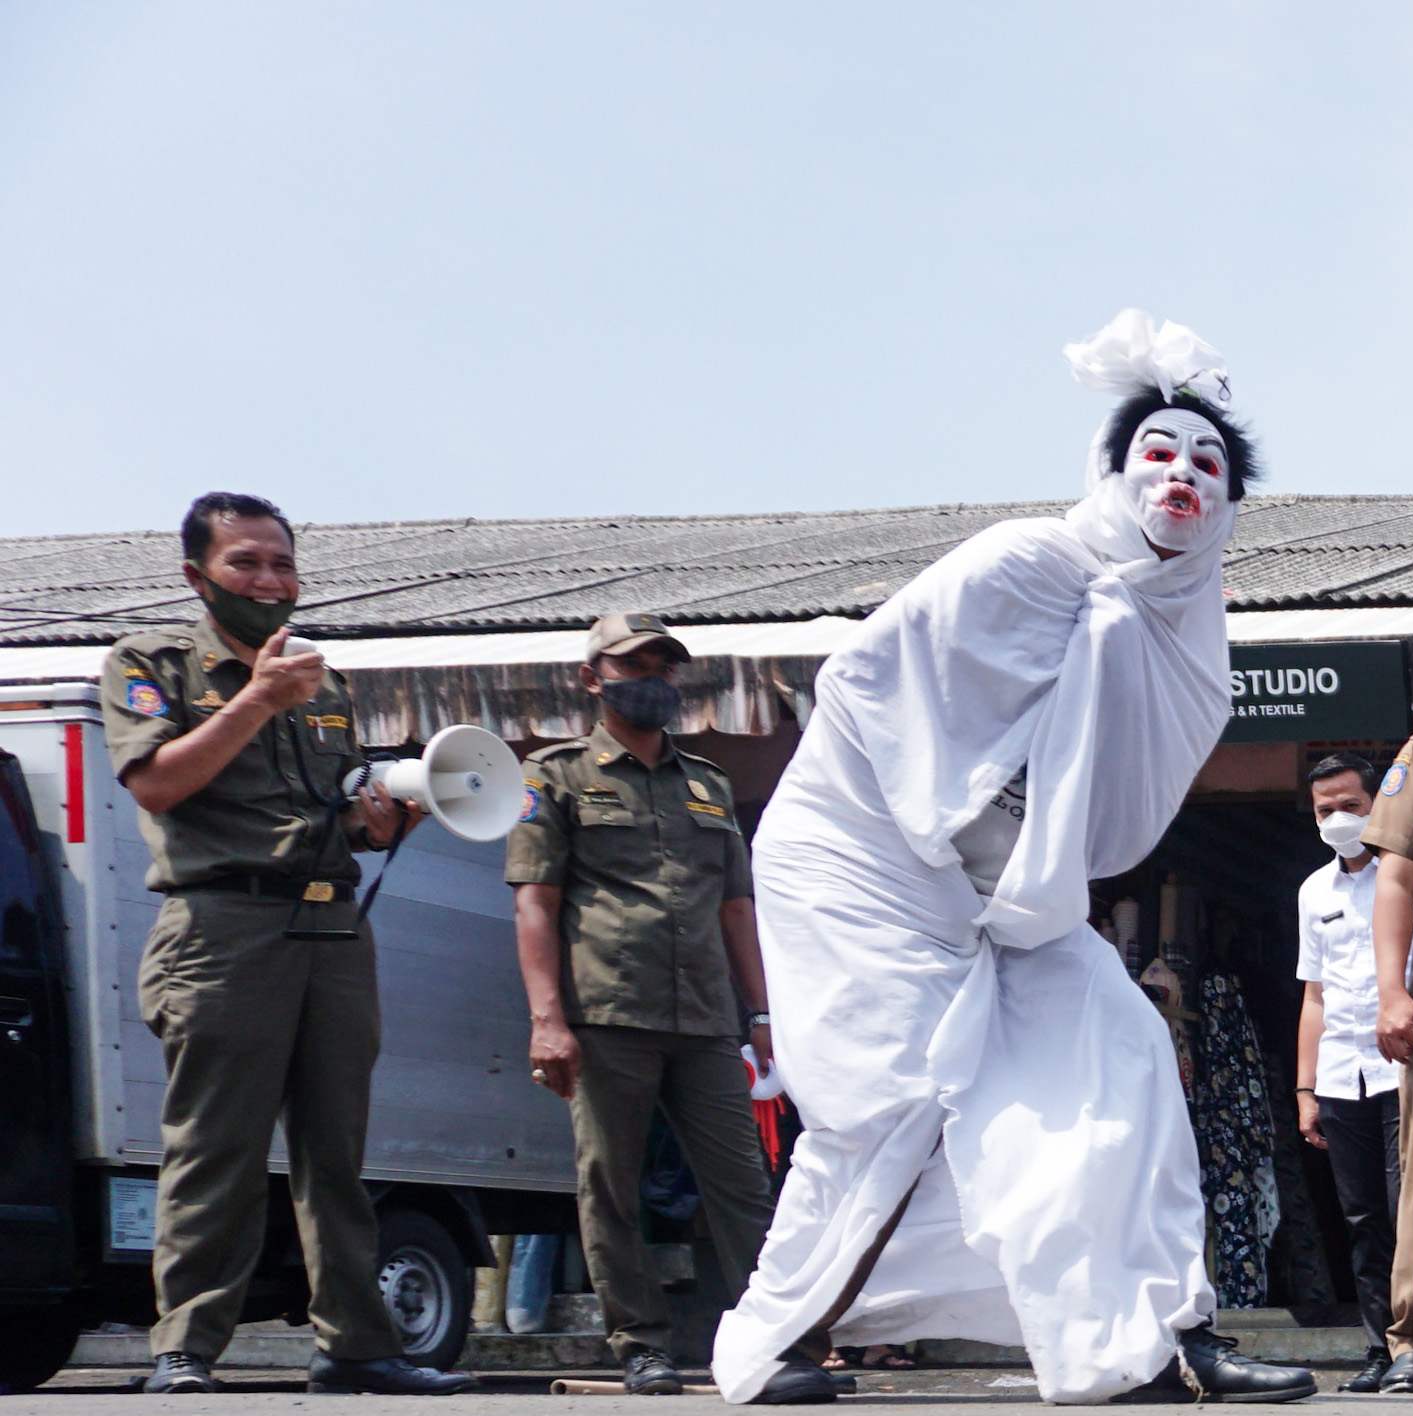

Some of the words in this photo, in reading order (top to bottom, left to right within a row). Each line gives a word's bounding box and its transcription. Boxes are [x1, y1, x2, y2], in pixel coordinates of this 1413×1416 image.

[1230, 667, 1339, 697] STUDIO
[1248, 705, 1258, 717] R
[1259, 703, 1306, 716] TEXTILE
